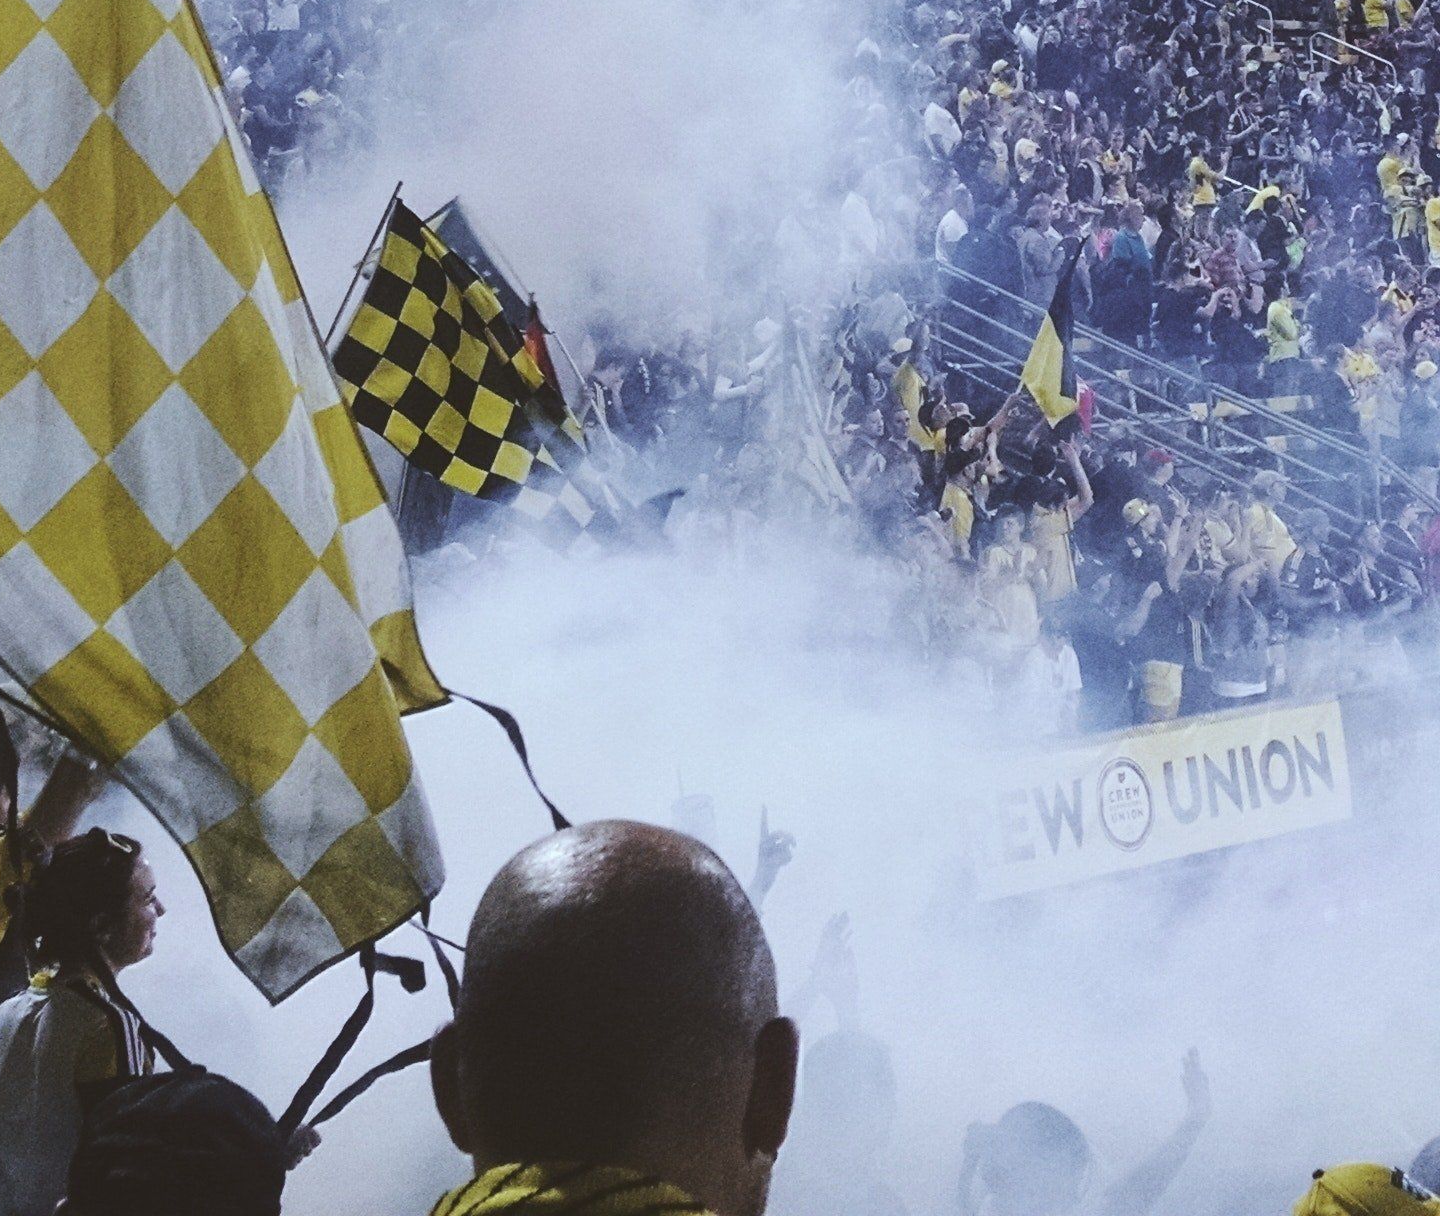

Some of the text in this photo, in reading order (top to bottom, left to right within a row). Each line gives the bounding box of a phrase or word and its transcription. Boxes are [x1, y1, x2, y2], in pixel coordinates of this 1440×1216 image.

[996, 732, 1334, 864] EW UNION
[1109, 786, 1140, 803] CREW
[1111, 808, 1144, 824] UNION
